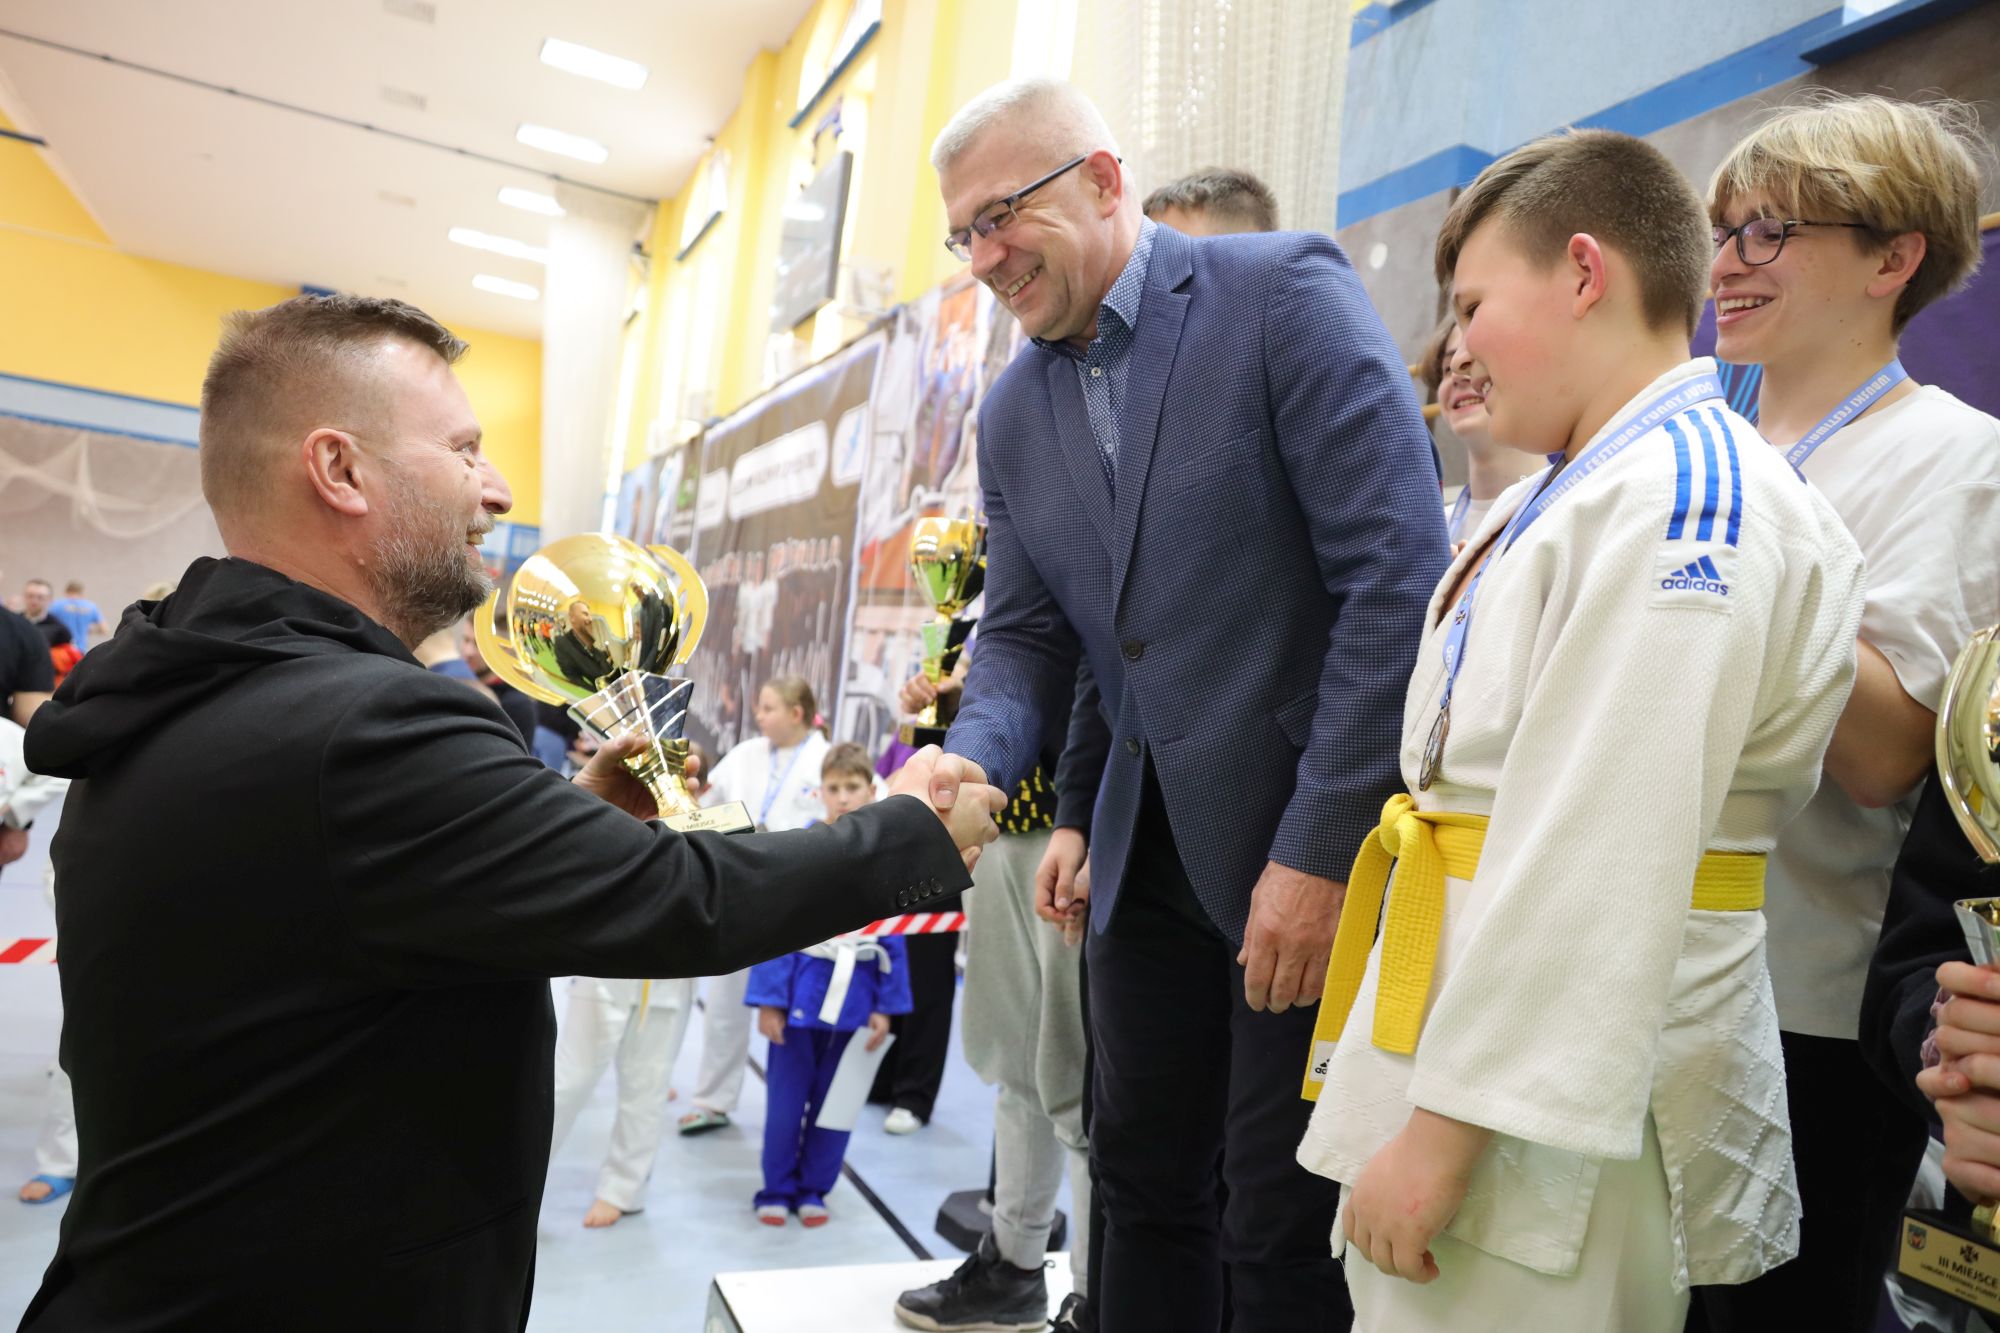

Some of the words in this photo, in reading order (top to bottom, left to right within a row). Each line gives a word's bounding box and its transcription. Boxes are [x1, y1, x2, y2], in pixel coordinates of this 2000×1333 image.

[1584, 424, 1644, 473] FESTIWAL
[1641, 392, 1686, 426] FUNNY
[1682, 380, 1715, 401] JUDO
[1660, 575, 1729, 597] adidas
[1938, 1255, 1949, 1269] III
[1951, 1261, 1998, 1288] MIEJSCE
